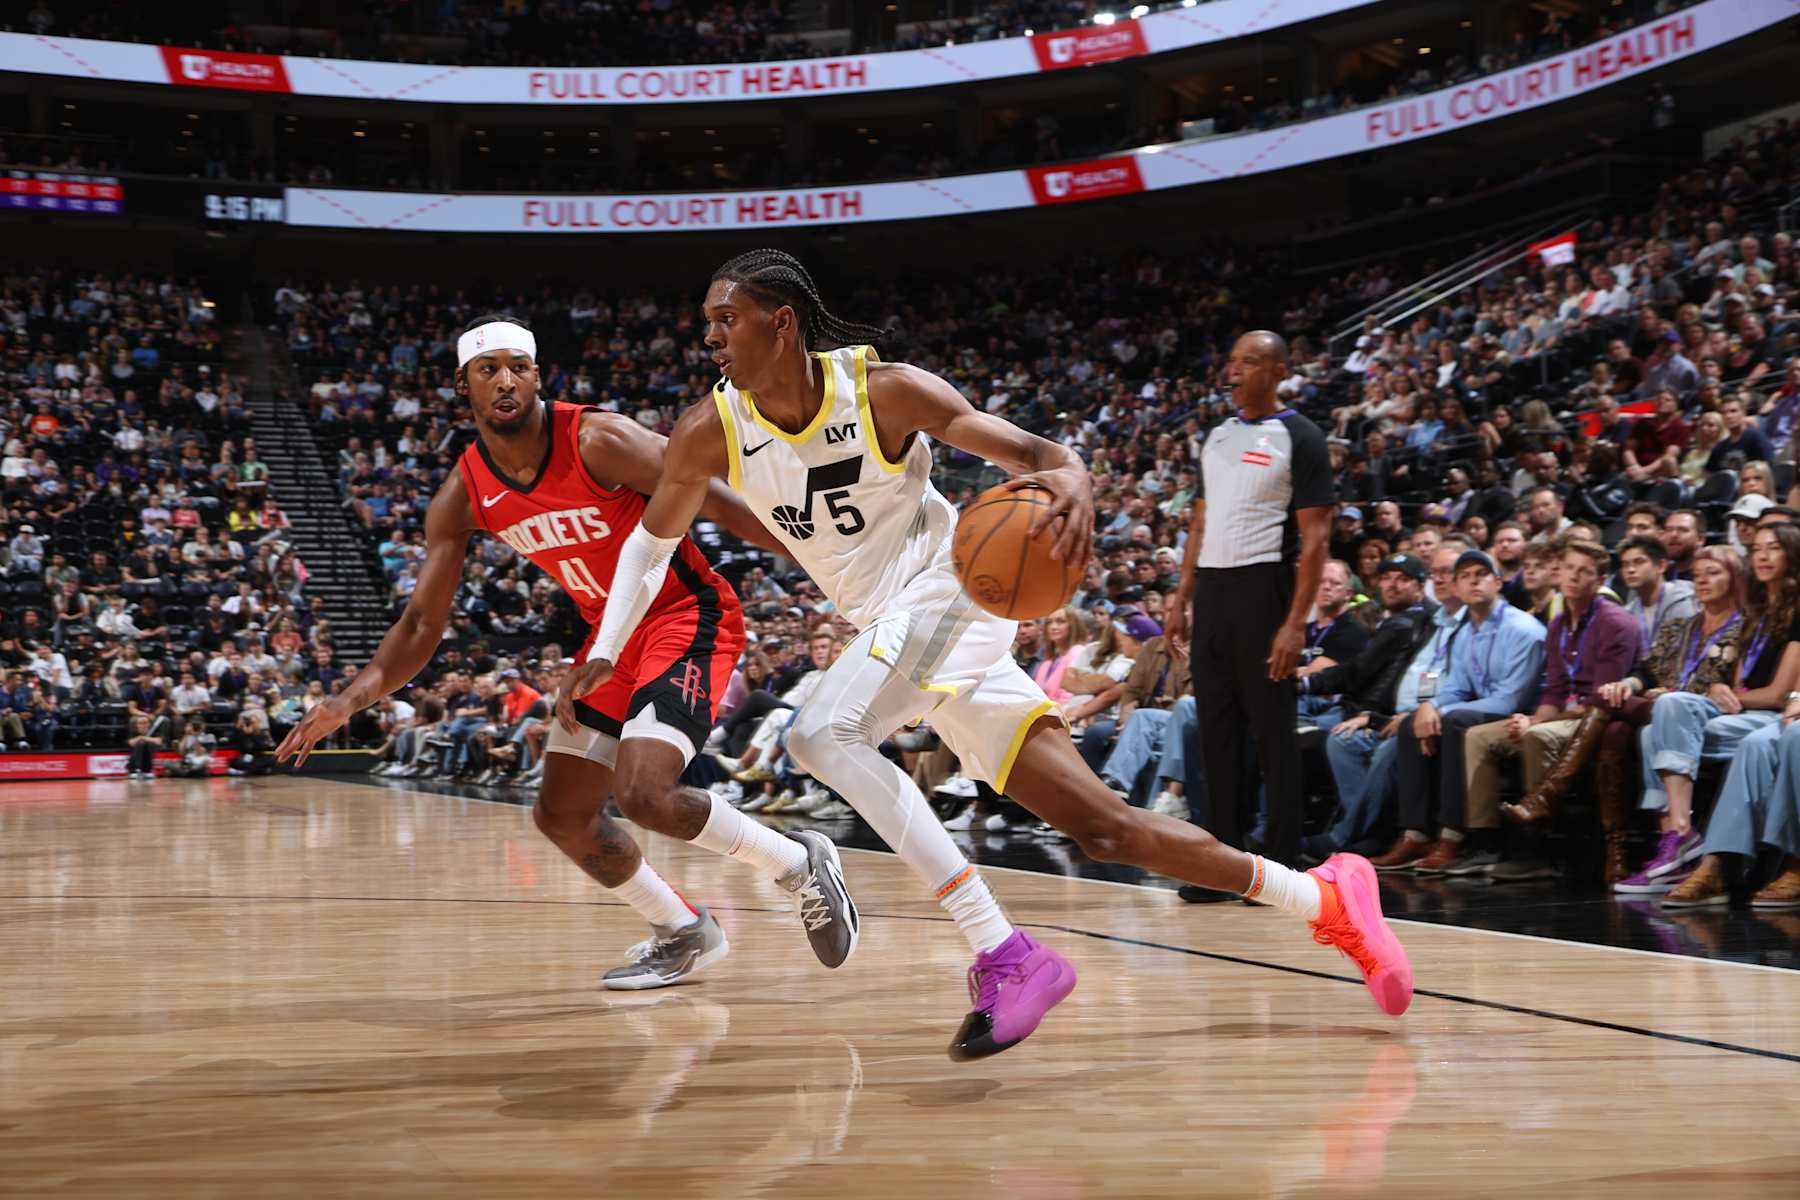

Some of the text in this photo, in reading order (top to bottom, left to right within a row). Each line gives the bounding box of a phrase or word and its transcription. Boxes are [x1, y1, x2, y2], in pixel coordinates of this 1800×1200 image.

[528, 61, 867, 98] FULL COURT HEALTH
[1366, 14, 1696, 143] FULL COURT HEALTH
[522, 191, 863, 227] FULL COURT HEALTH
[824, 422, 857, 445] LVT
[497, 506, 611, 555] ROCKETS
[823, 489, 866, 536] 5
[557, 557, 608, 599] 41
